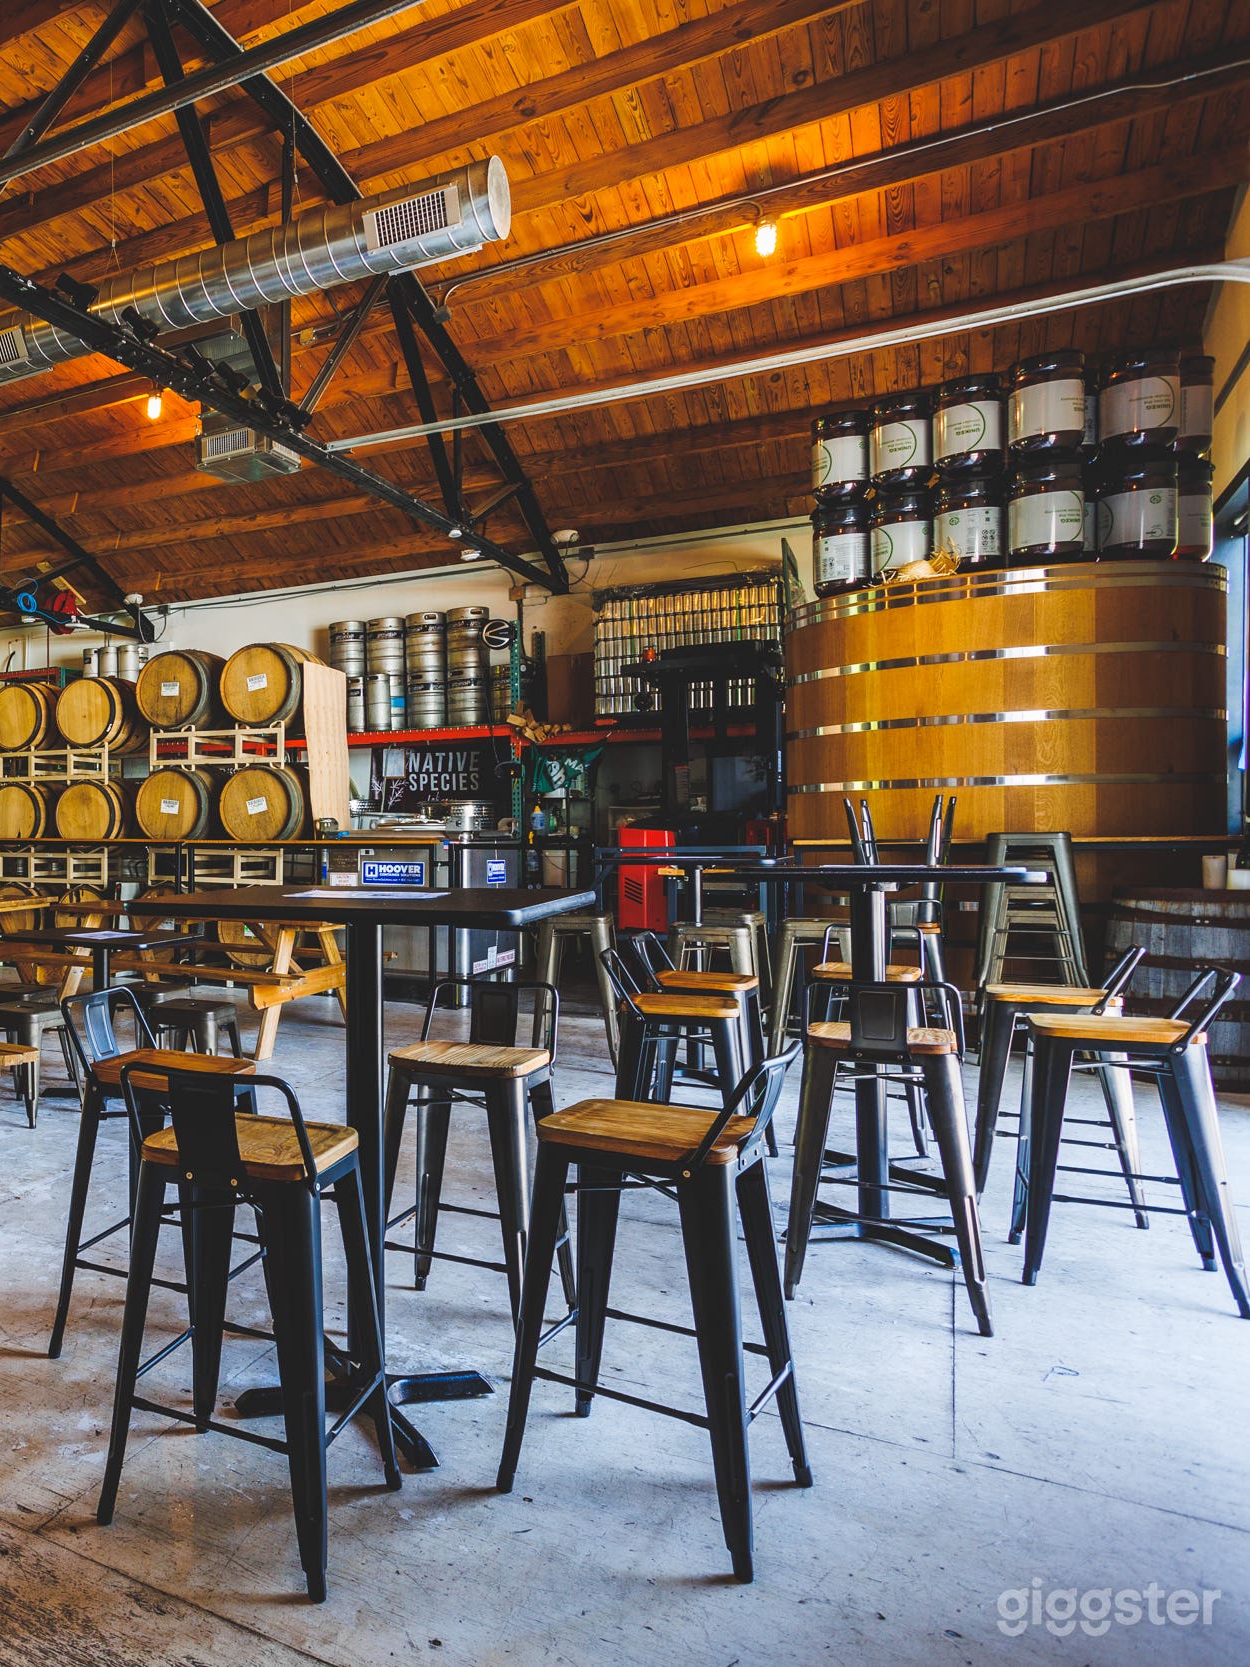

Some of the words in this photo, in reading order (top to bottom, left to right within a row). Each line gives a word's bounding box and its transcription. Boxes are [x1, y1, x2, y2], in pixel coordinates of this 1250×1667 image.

[408, 751, 480, 773] NATIVE
[408, 772, 479, 792] SPECIES
[379, 864, 421, 873] HOOVER
